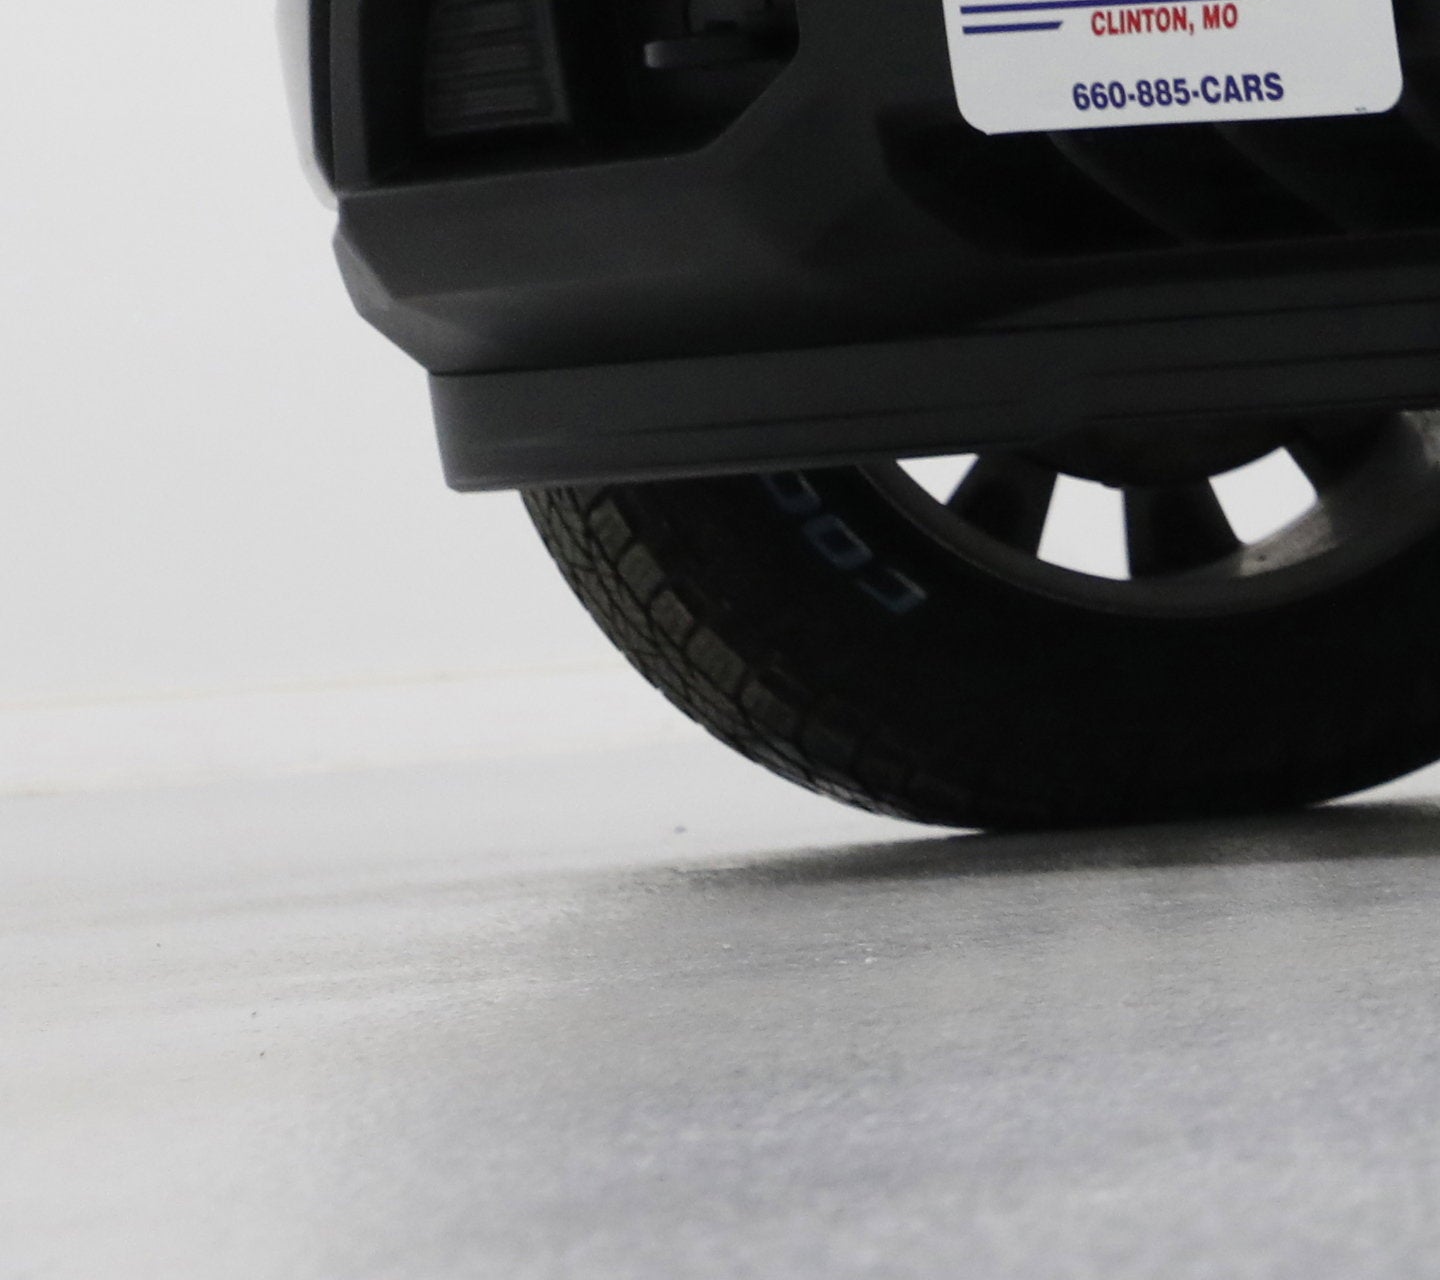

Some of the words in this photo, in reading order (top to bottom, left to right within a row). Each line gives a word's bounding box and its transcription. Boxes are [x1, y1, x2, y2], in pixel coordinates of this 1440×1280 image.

[1091, 6, 1195, 36] CLINTON,
[1203, 3, 1239, 28] MO
[1072, 72, 1284, 112] 660-885-CARS
